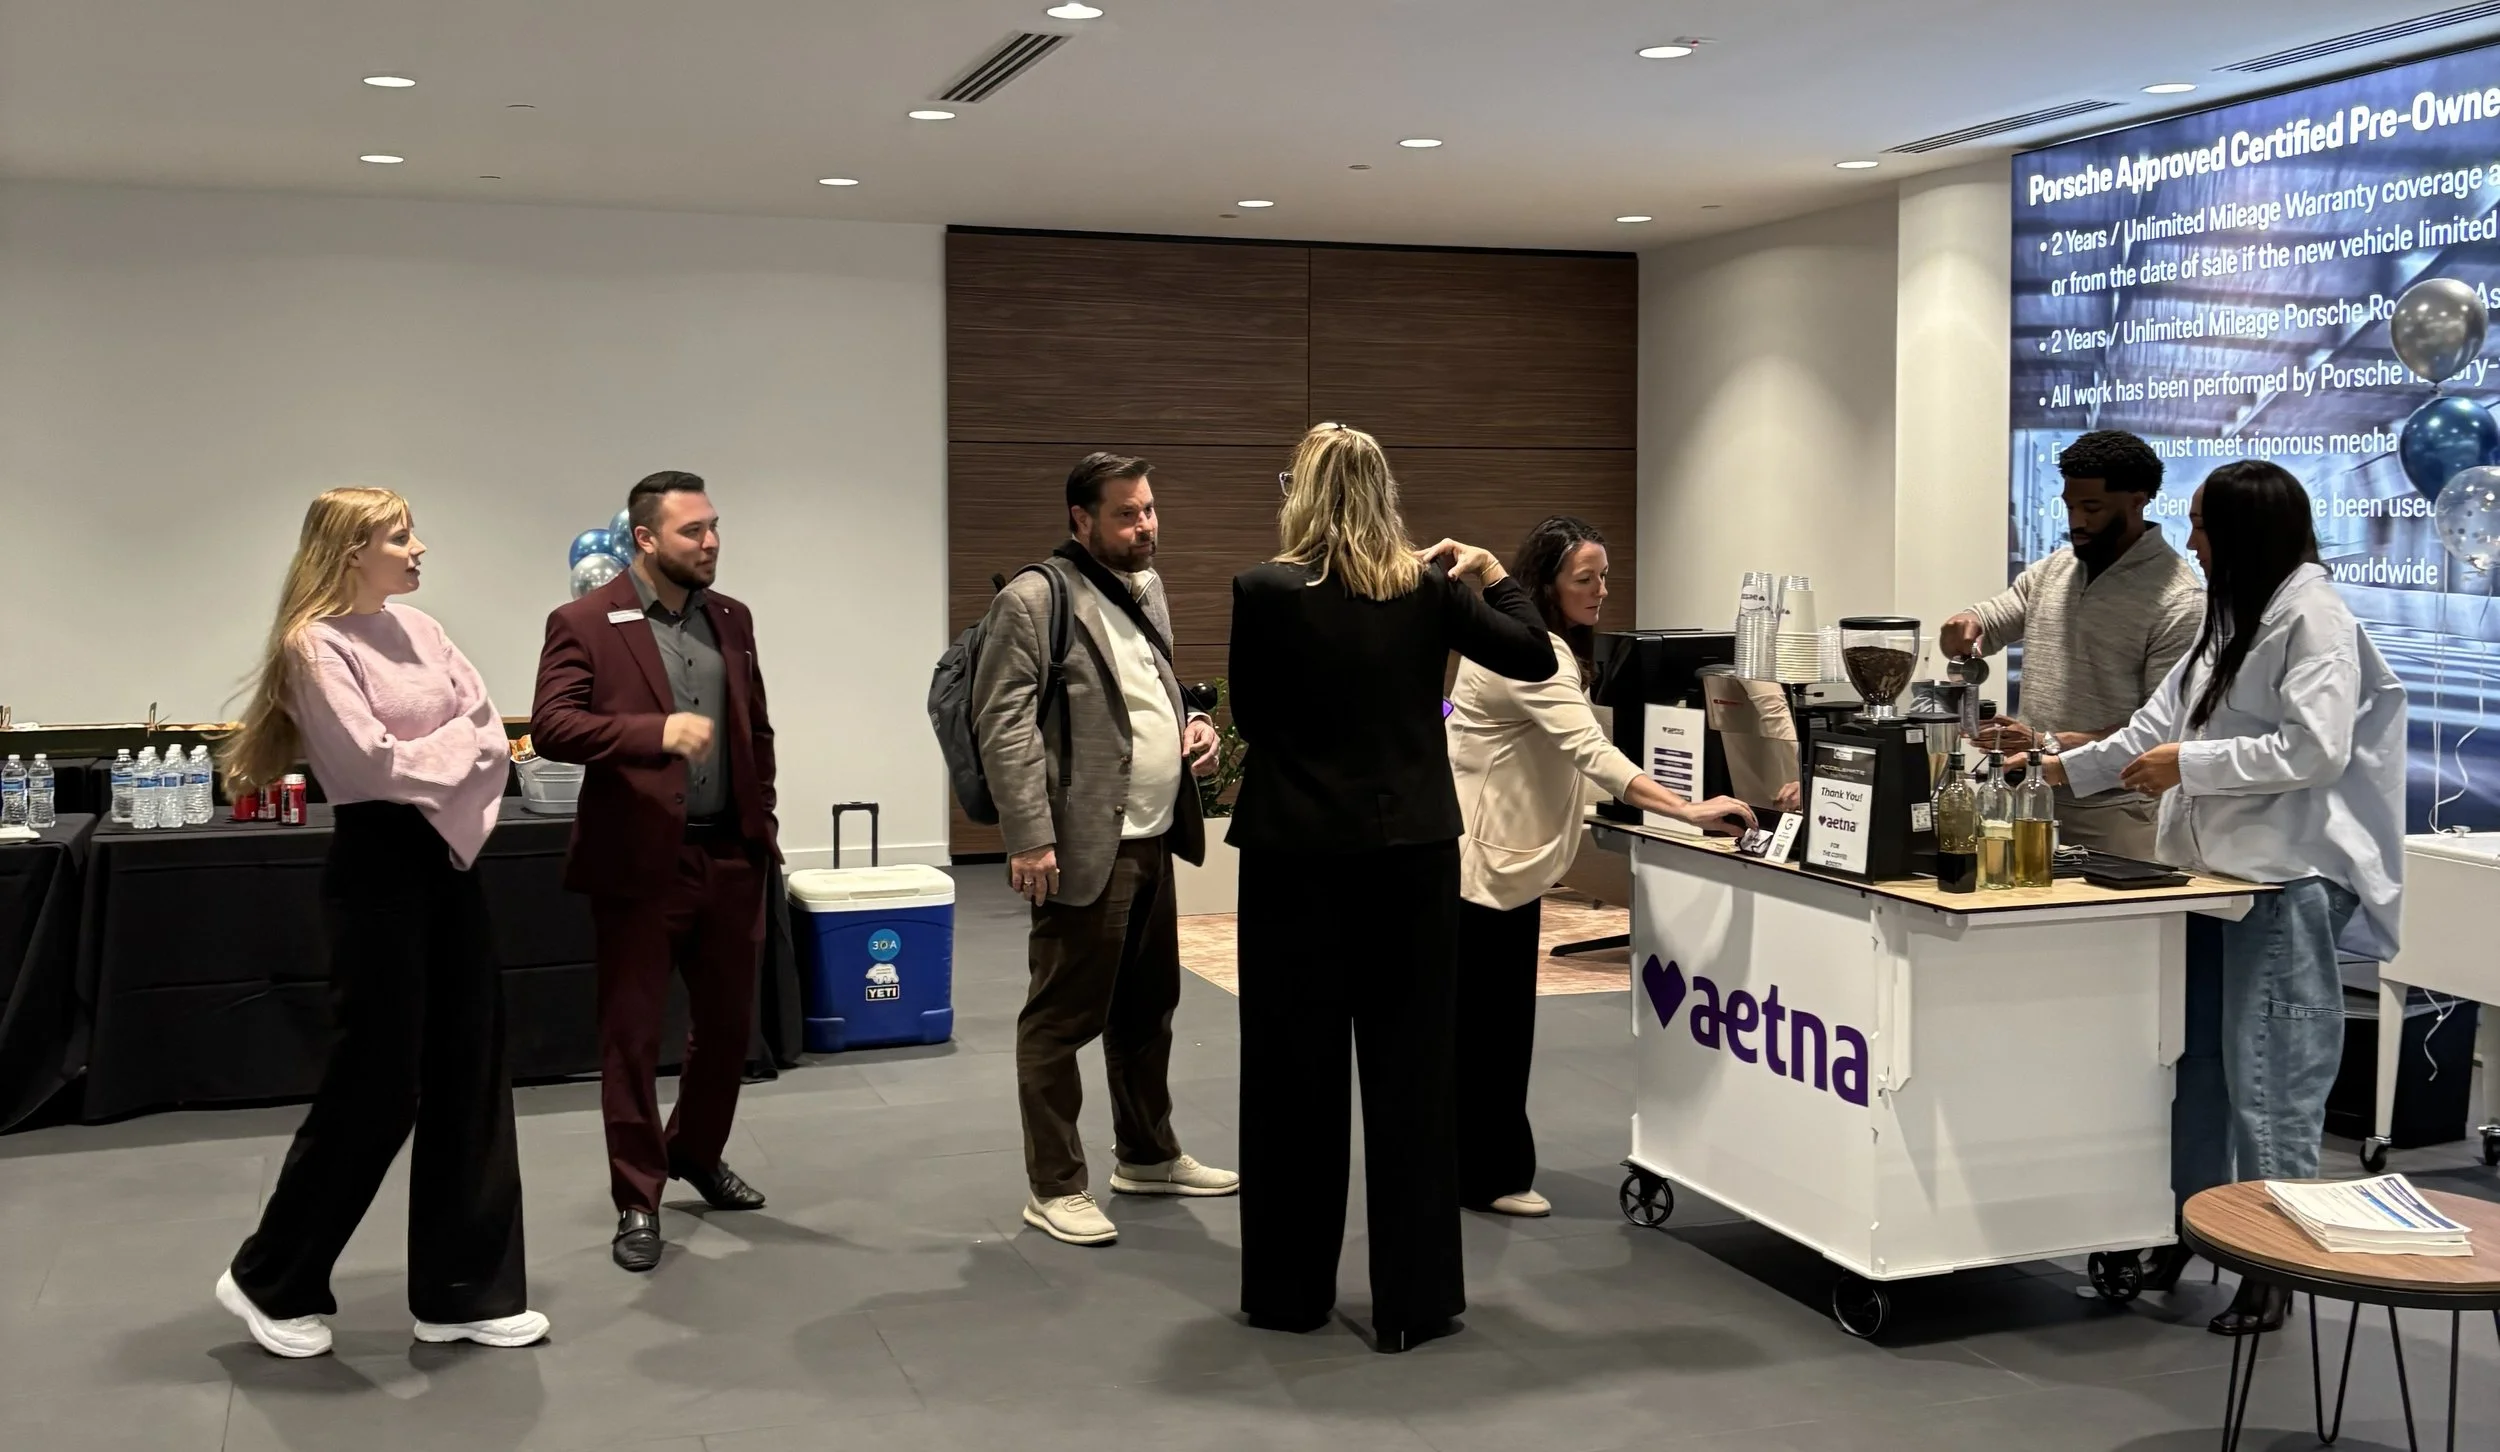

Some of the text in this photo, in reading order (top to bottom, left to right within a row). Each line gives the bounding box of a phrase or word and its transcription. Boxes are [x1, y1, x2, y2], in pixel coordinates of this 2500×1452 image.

[2029, 164, 2113, 206] Porsche
[2115, 136, 2226, 194] Approved
[2231, 110, 2344, 167] Certified
[2052, 232, 2063, 256] 2
[2066, 229, 2107, 252] Years
[2110, 221, 2120, 246] /
[2124, 208, 2204, 243] Unlimited
[2210, 201, 2281, 231] Mileage
[2285, 183, 2378, 219] Warranty
[2382, 166, 2482, 203] coverage
[2052, 209, 2497, 297] or from the date of sale if the new vehicle limited
[2051, 330, 2062, 354] 2
[2065, 327, 2107, 351] Years
[2123, 312, 2203, 344] Unlimited
[2209, 308, 2279, 338] Mileage
[2285, 298, 2363, 329] Porsche
[2051, 383, 2070, 408] All
[2074, 380, 2112, 405] work
[2116, 379, 2144, 403] has
[2148, 376, 2188, 399] been
[2194, 366, 2288, 402] performed
[2293, 365, 2316, 397] by
[2321, 359, 2403, 389] Porsche
[2150, 427, 2398, 460] must meet rigorous mecha
[2333, 492, 2382, 518] been
[2331, 557, 2438, 585] worldwide
[1821, 787, 1863, 802] Thank You!
[1826, 817, 1856, 832] aetna
[869, 987, 896, 998] YETI
[1690, 976, 1869, 1108] aetna
